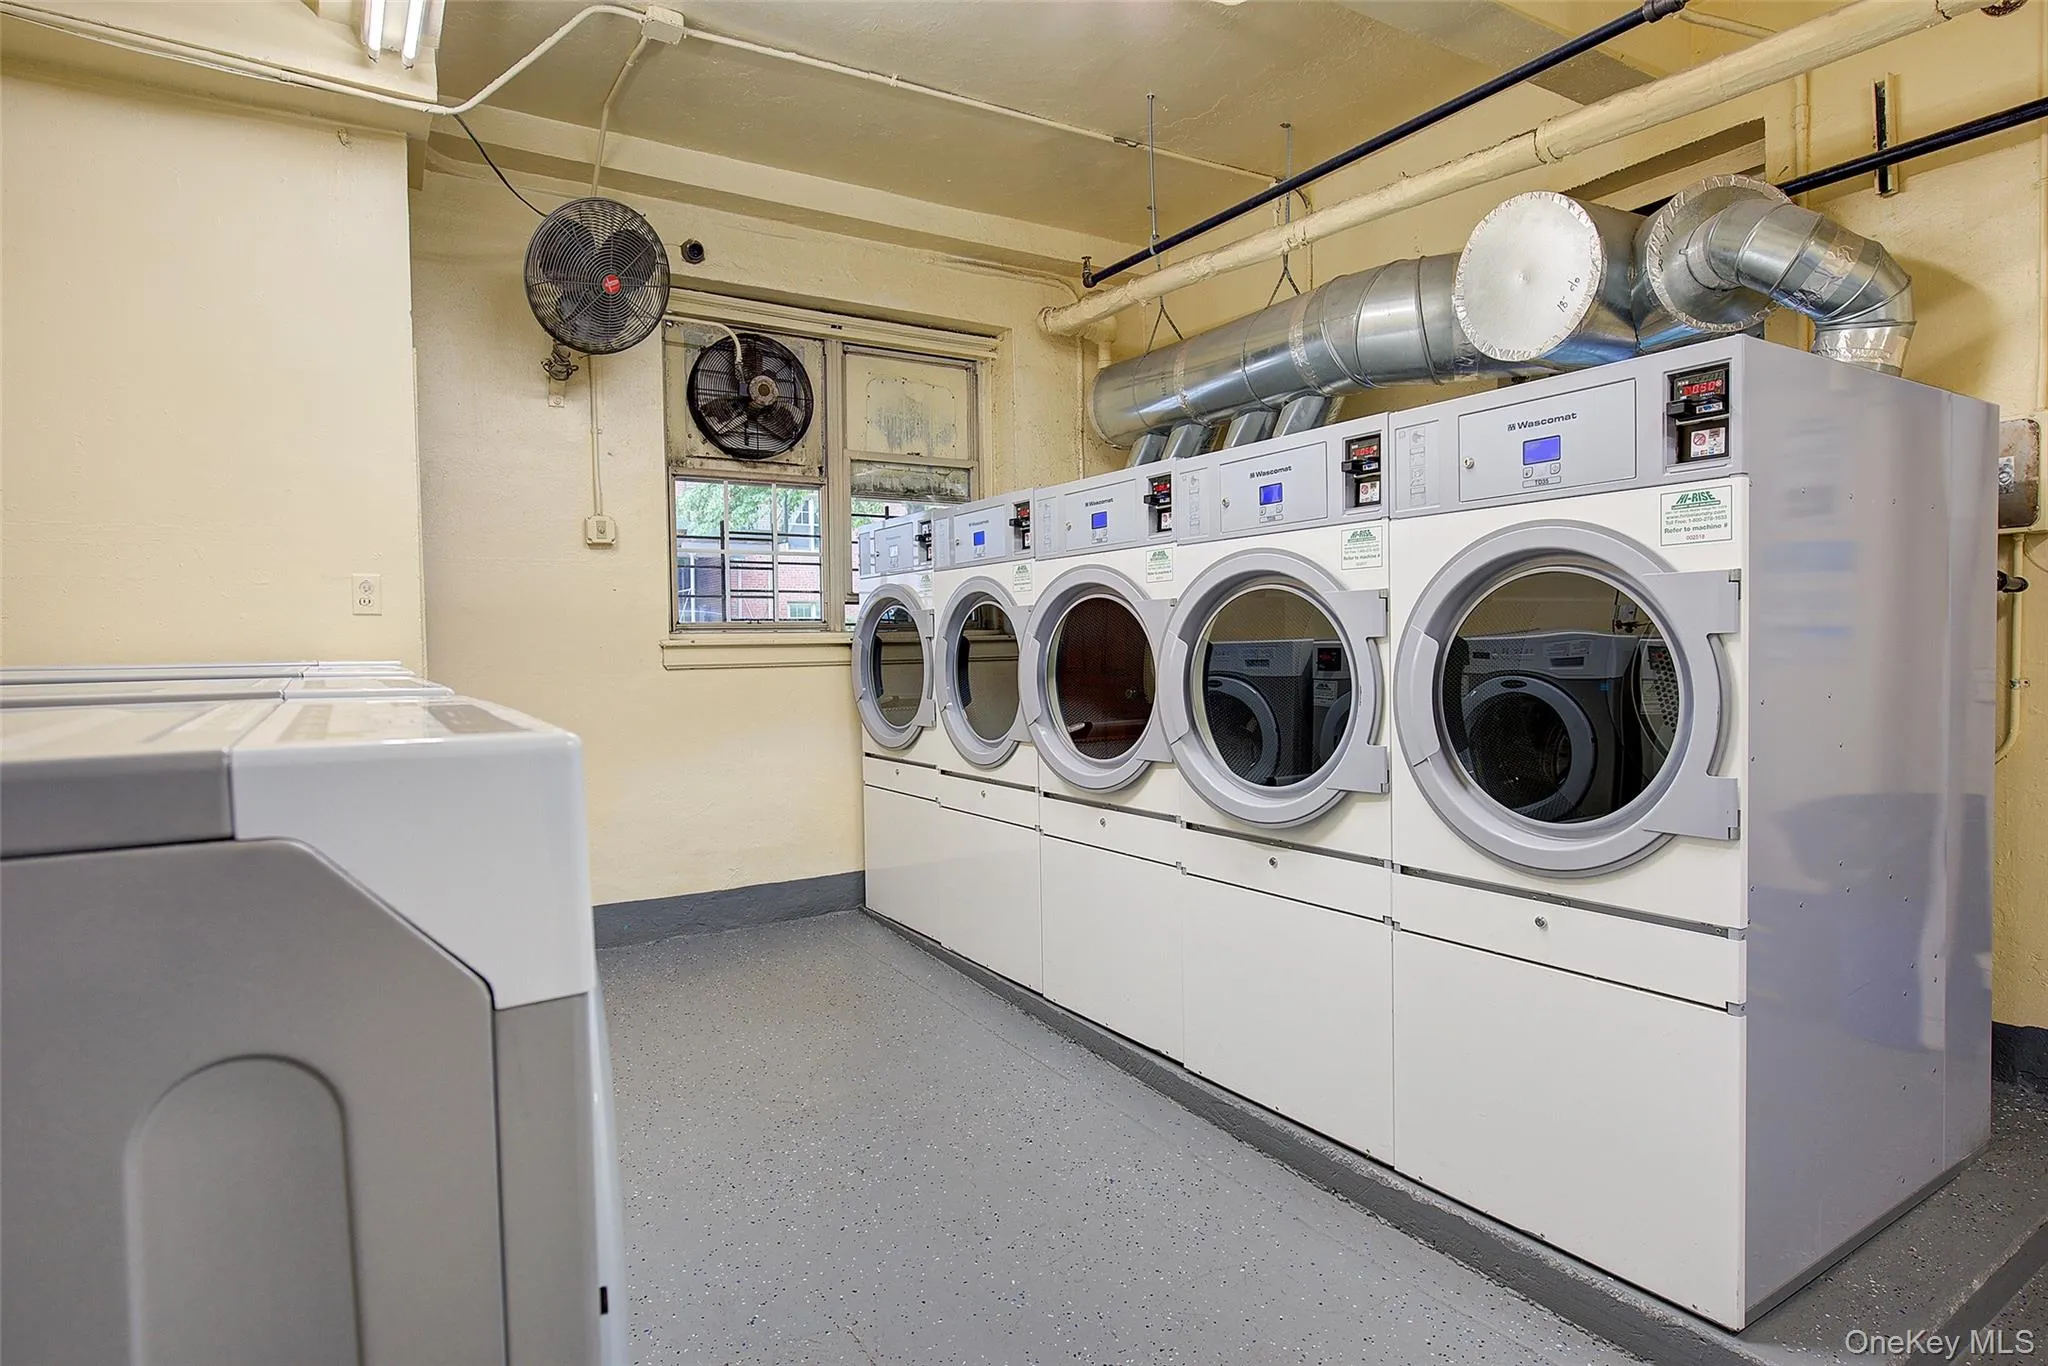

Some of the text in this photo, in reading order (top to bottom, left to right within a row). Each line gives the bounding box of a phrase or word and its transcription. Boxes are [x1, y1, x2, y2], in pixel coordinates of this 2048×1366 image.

[1517, 412, 1577, 429] Wascomat
[1256, 465, 1292, 478] Wascomat
[1676, 491, 1716, 504] HI-RISE
[1692, 523, 1722, 532] machine
